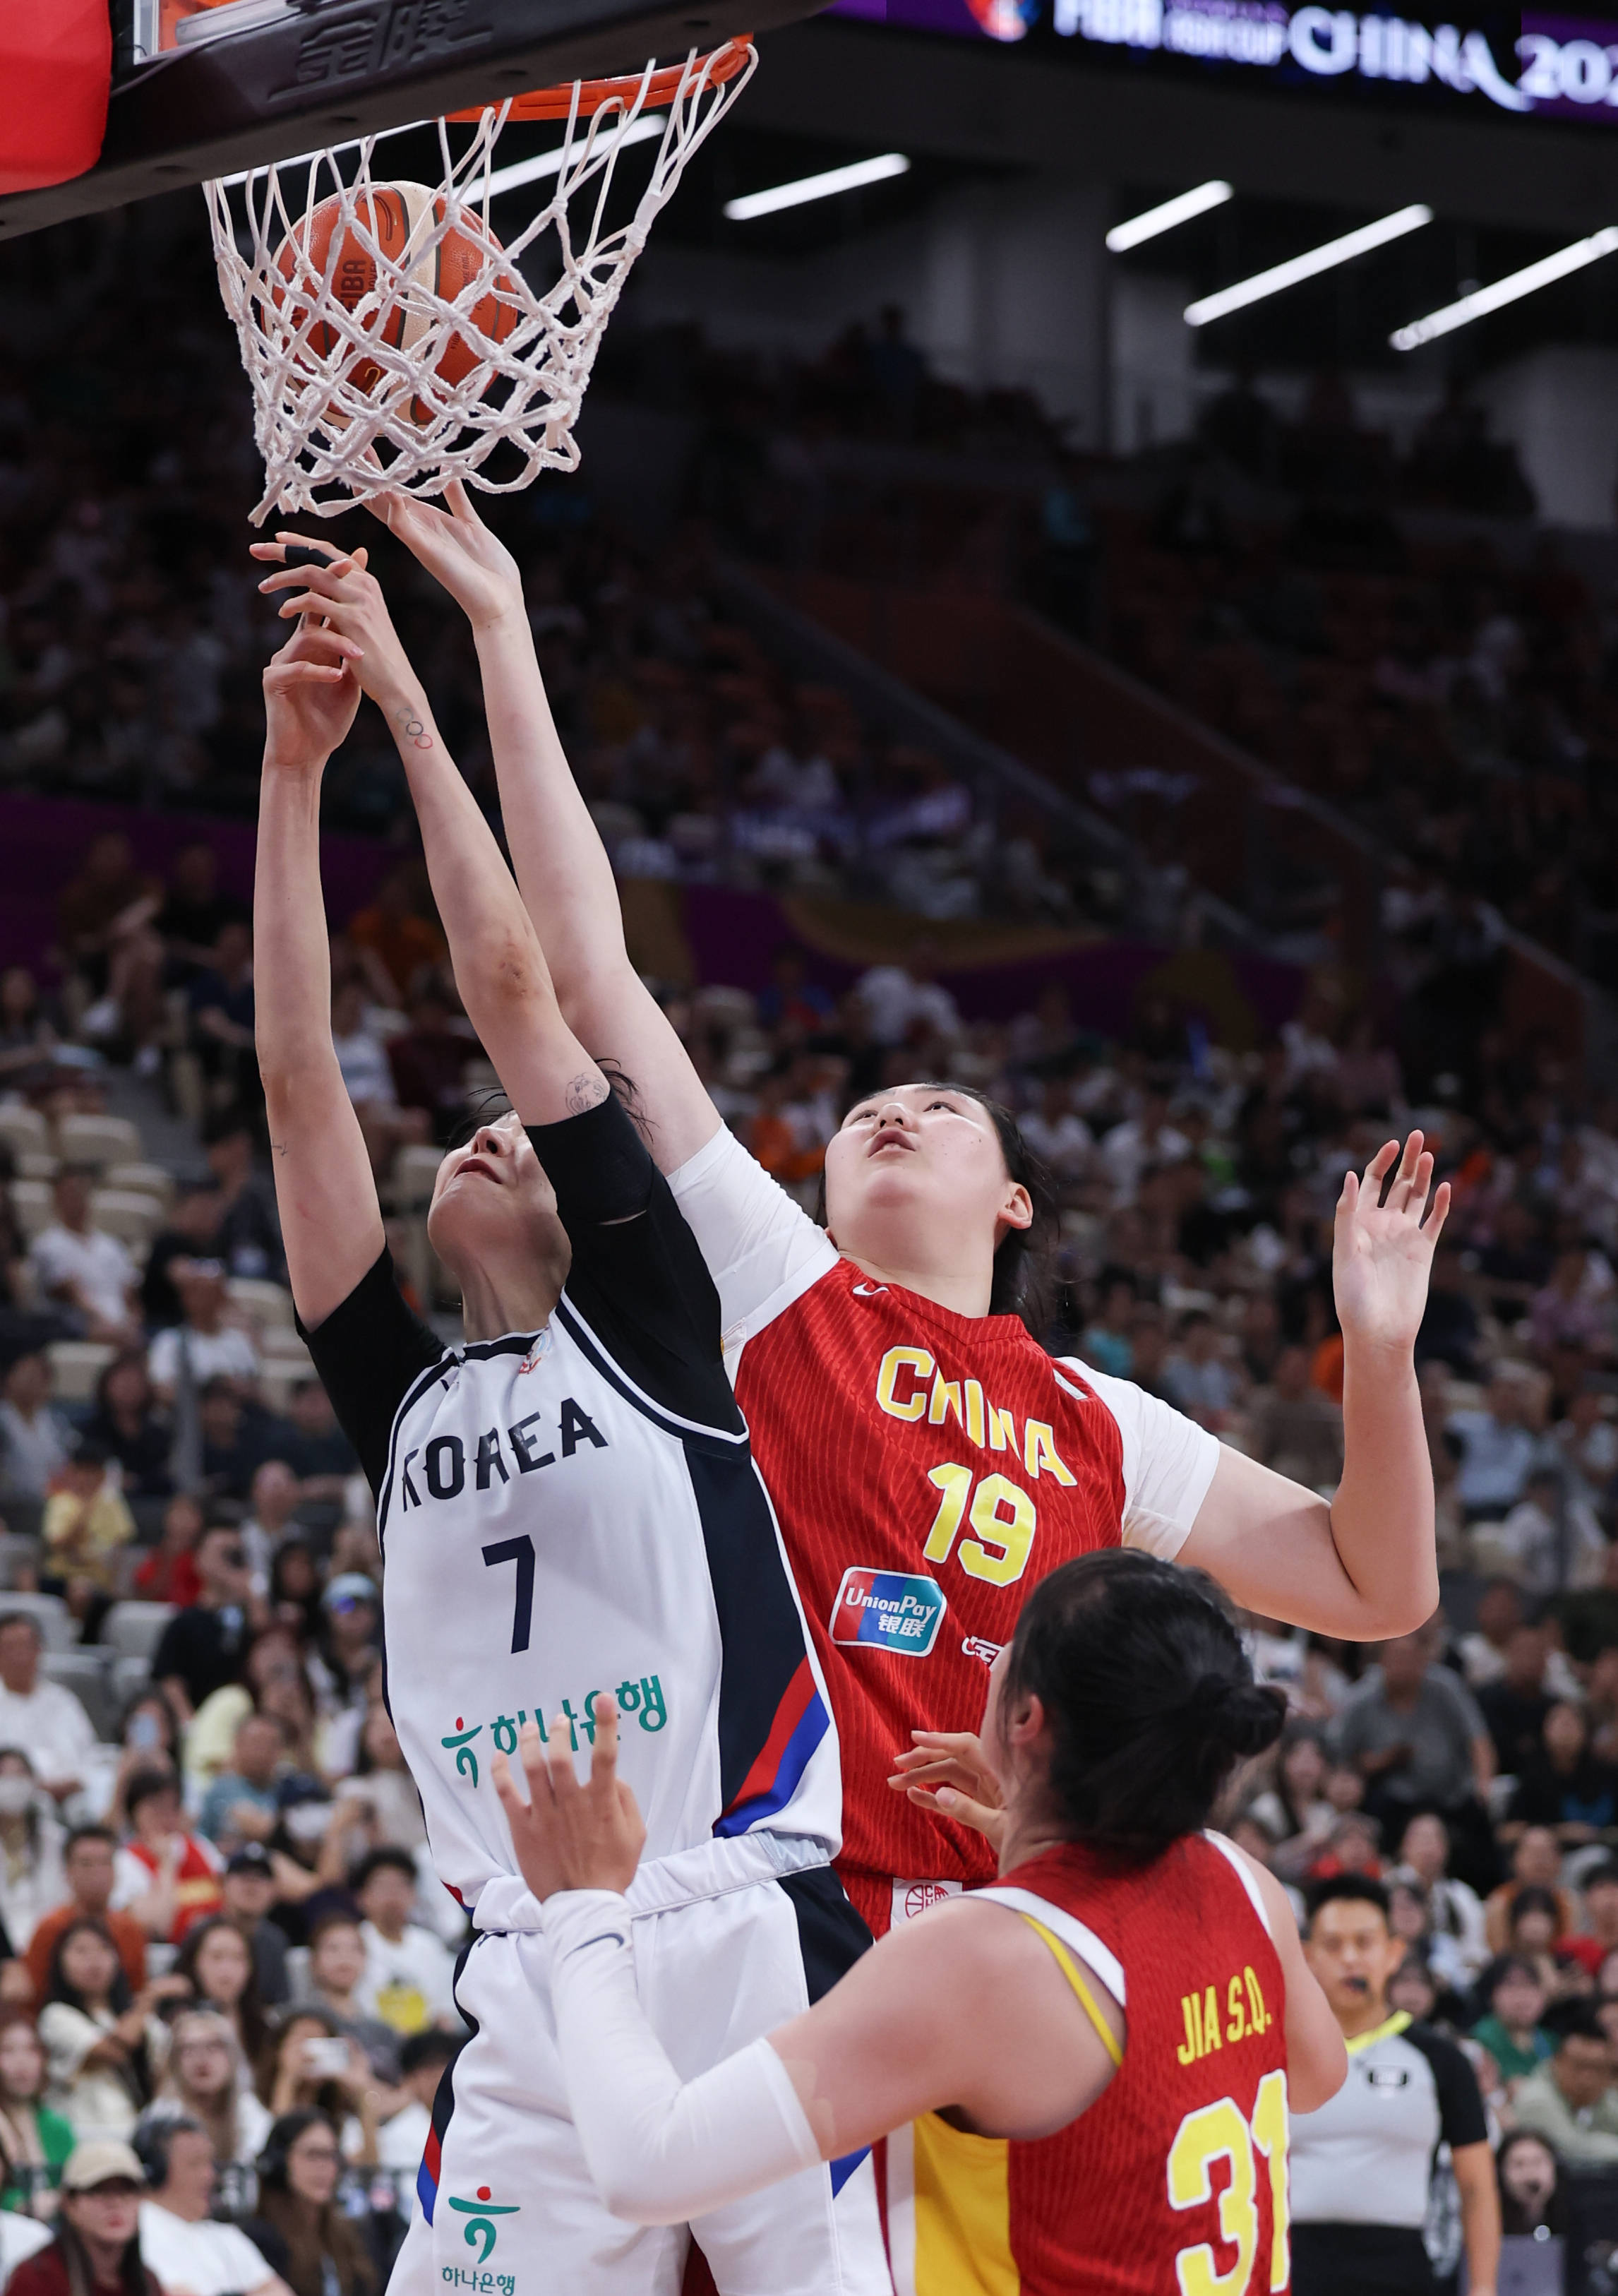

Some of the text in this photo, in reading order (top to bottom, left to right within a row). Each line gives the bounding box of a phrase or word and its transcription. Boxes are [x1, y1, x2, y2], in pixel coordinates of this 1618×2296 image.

[876, 1346, 1077, 1486] CHINA
[923, 1462, 1036, 1587] 19
[481, 1534, 535, 1654] 7
[846, 1587, 937, 1624] UnionPay
[878, 1613, 925, 1637] 银联
[1177, 1966, 1272, 2066] JIA S.Q.
[1167, 2069, 1290, 2296] 31
[442, 2266, 515, 2296] 하나은행
